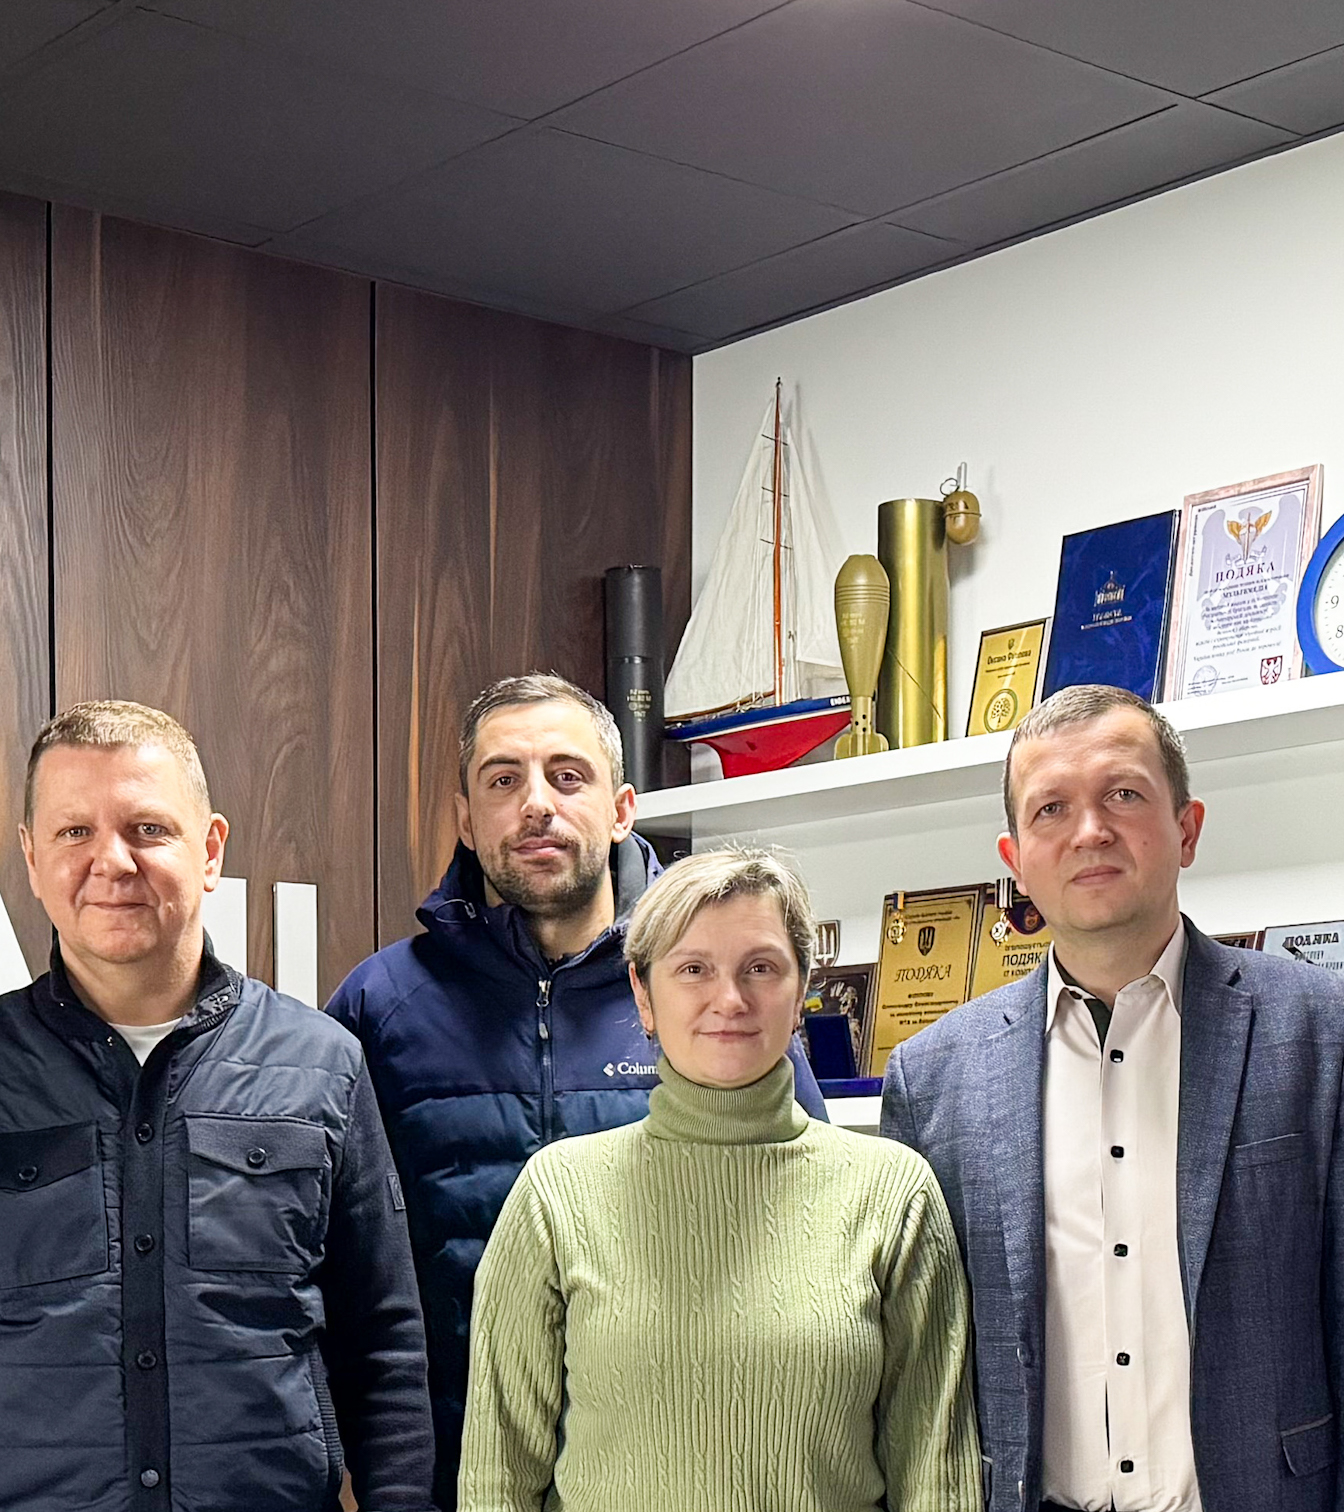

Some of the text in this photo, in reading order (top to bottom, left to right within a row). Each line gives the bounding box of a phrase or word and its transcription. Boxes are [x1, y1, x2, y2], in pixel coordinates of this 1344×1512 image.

[1216, 561, 1275, 583] ПОДЯКА
[1330, 595, 1340, 609] 9
[1335, 624, 1344, 638] 8
[1002, 951, 1043, 967] ПОДЯК
[894, 964, 952, 983] ПОДЯКА
[617, 1062, 659, 1075] Colum
